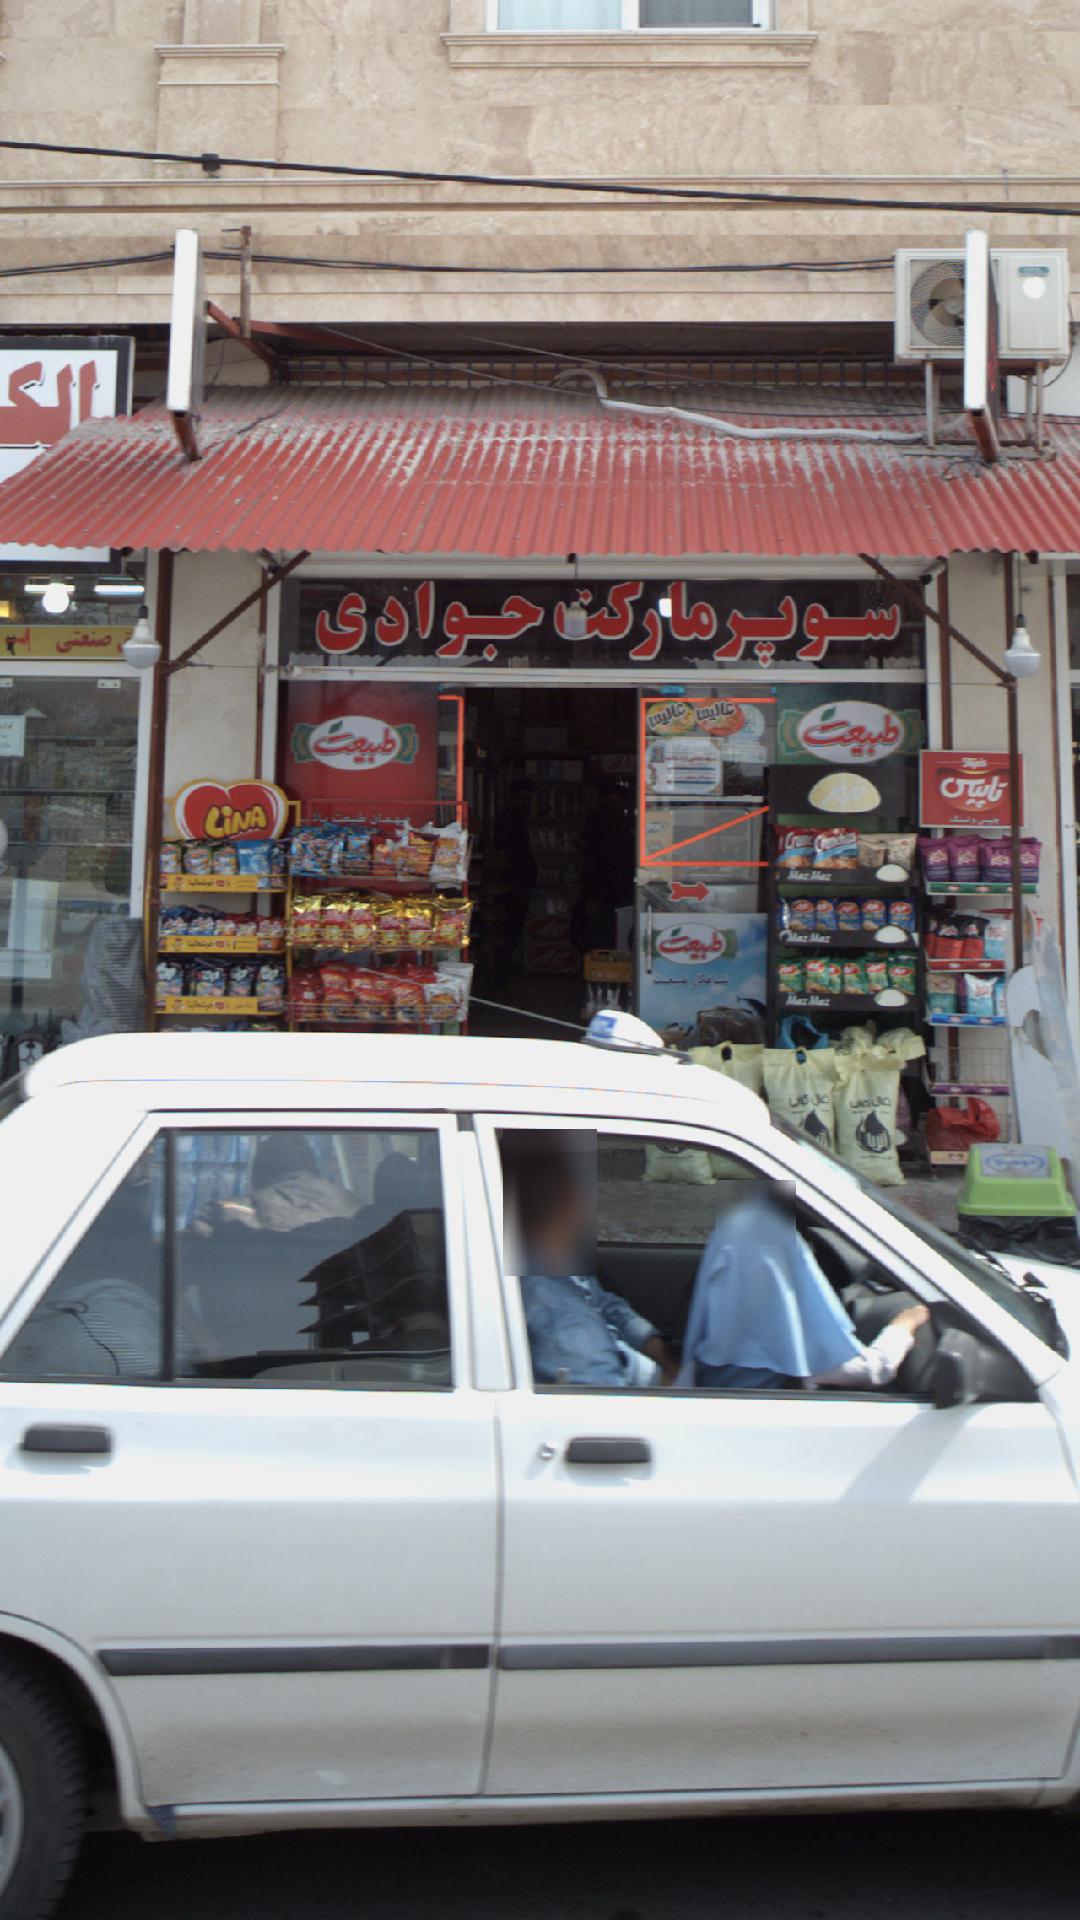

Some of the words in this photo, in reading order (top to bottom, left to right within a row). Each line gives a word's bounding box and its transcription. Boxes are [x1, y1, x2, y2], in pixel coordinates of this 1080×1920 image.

[314, 581, 545, 659] جوادی
[312, 727, 398, 764] طبیعت
[801, 714, 900, 757] طبیعت
[659, 929, 721, 959] طبیعت
